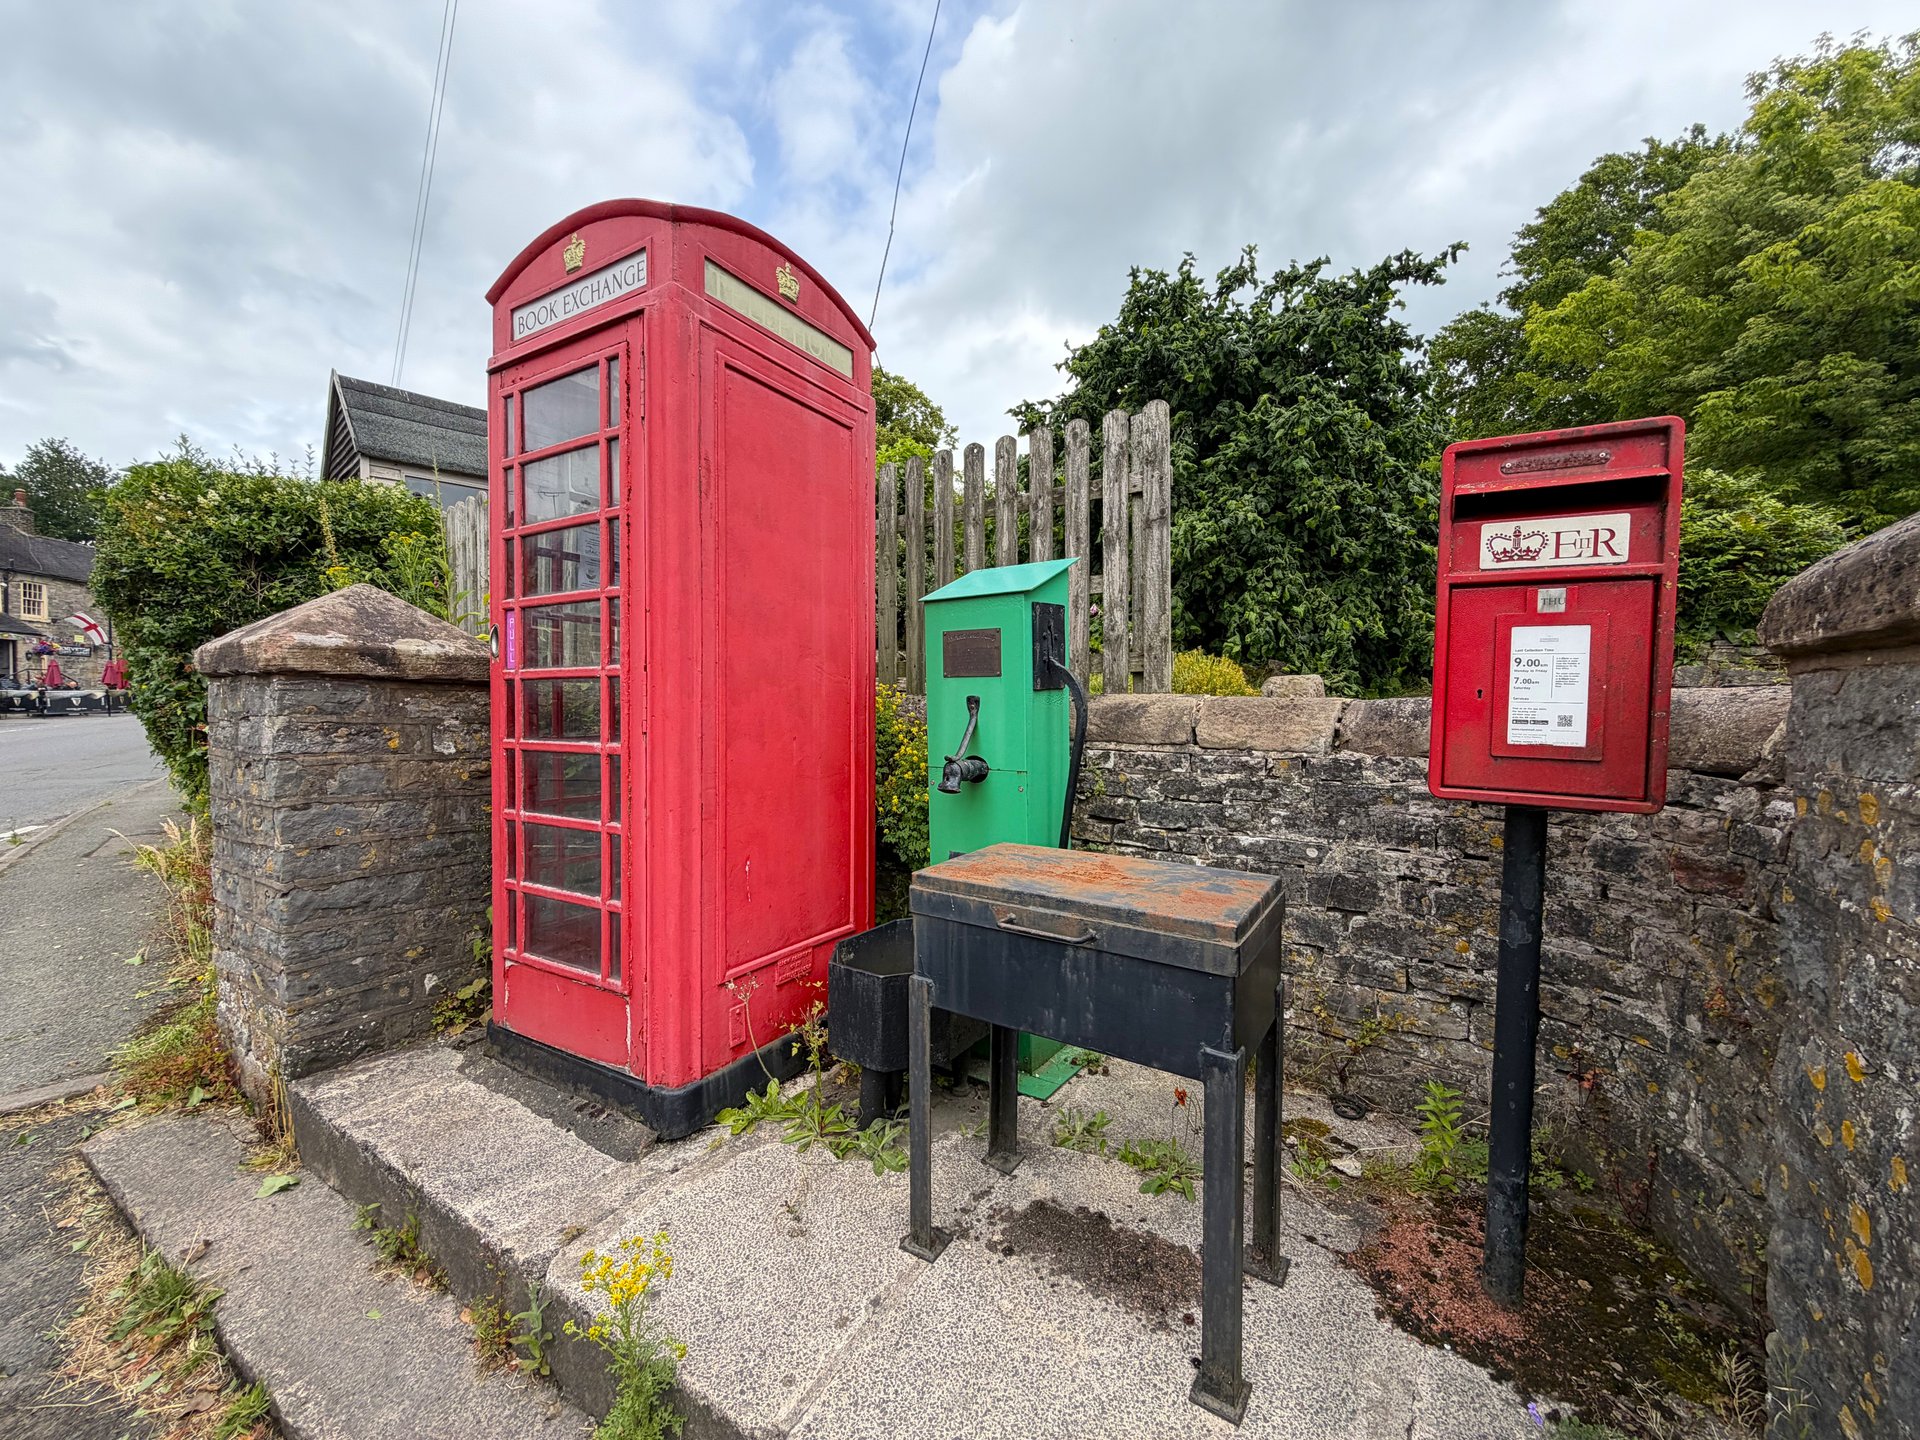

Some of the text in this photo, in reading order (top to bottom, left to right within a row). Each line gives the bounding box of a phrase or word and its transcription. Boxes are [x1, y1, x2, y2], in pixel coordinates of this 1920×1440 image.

[517, 259, 646, 335] BOOK EXCHANGE
[1541, 597, 1565, 606] THU
